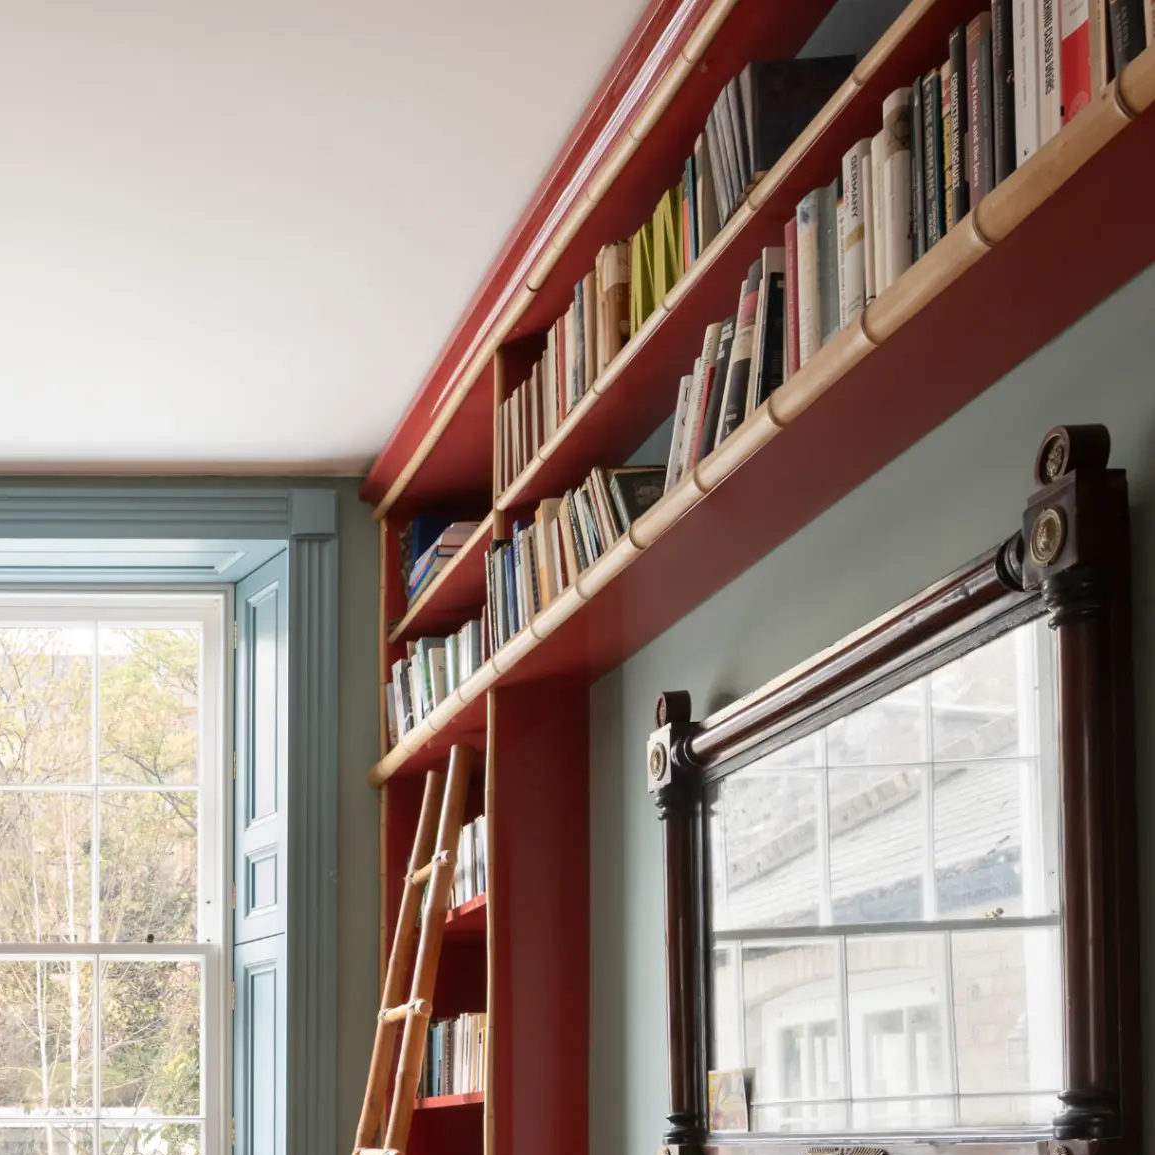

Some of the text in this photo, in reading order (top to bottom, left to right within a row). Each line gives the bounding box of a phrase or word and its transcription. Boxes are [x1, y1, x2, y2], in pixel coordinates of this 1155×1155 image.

[1044, 26, 1054, 63] CLOSED
[1045, 60, 1055, 96] DOORS
[925, 93, 935, 199] THE GERMANS
[950, 71, 961, 190] FORGOTTEN HOLOCAUST
[850, 154, 859, 218] GERMANY
